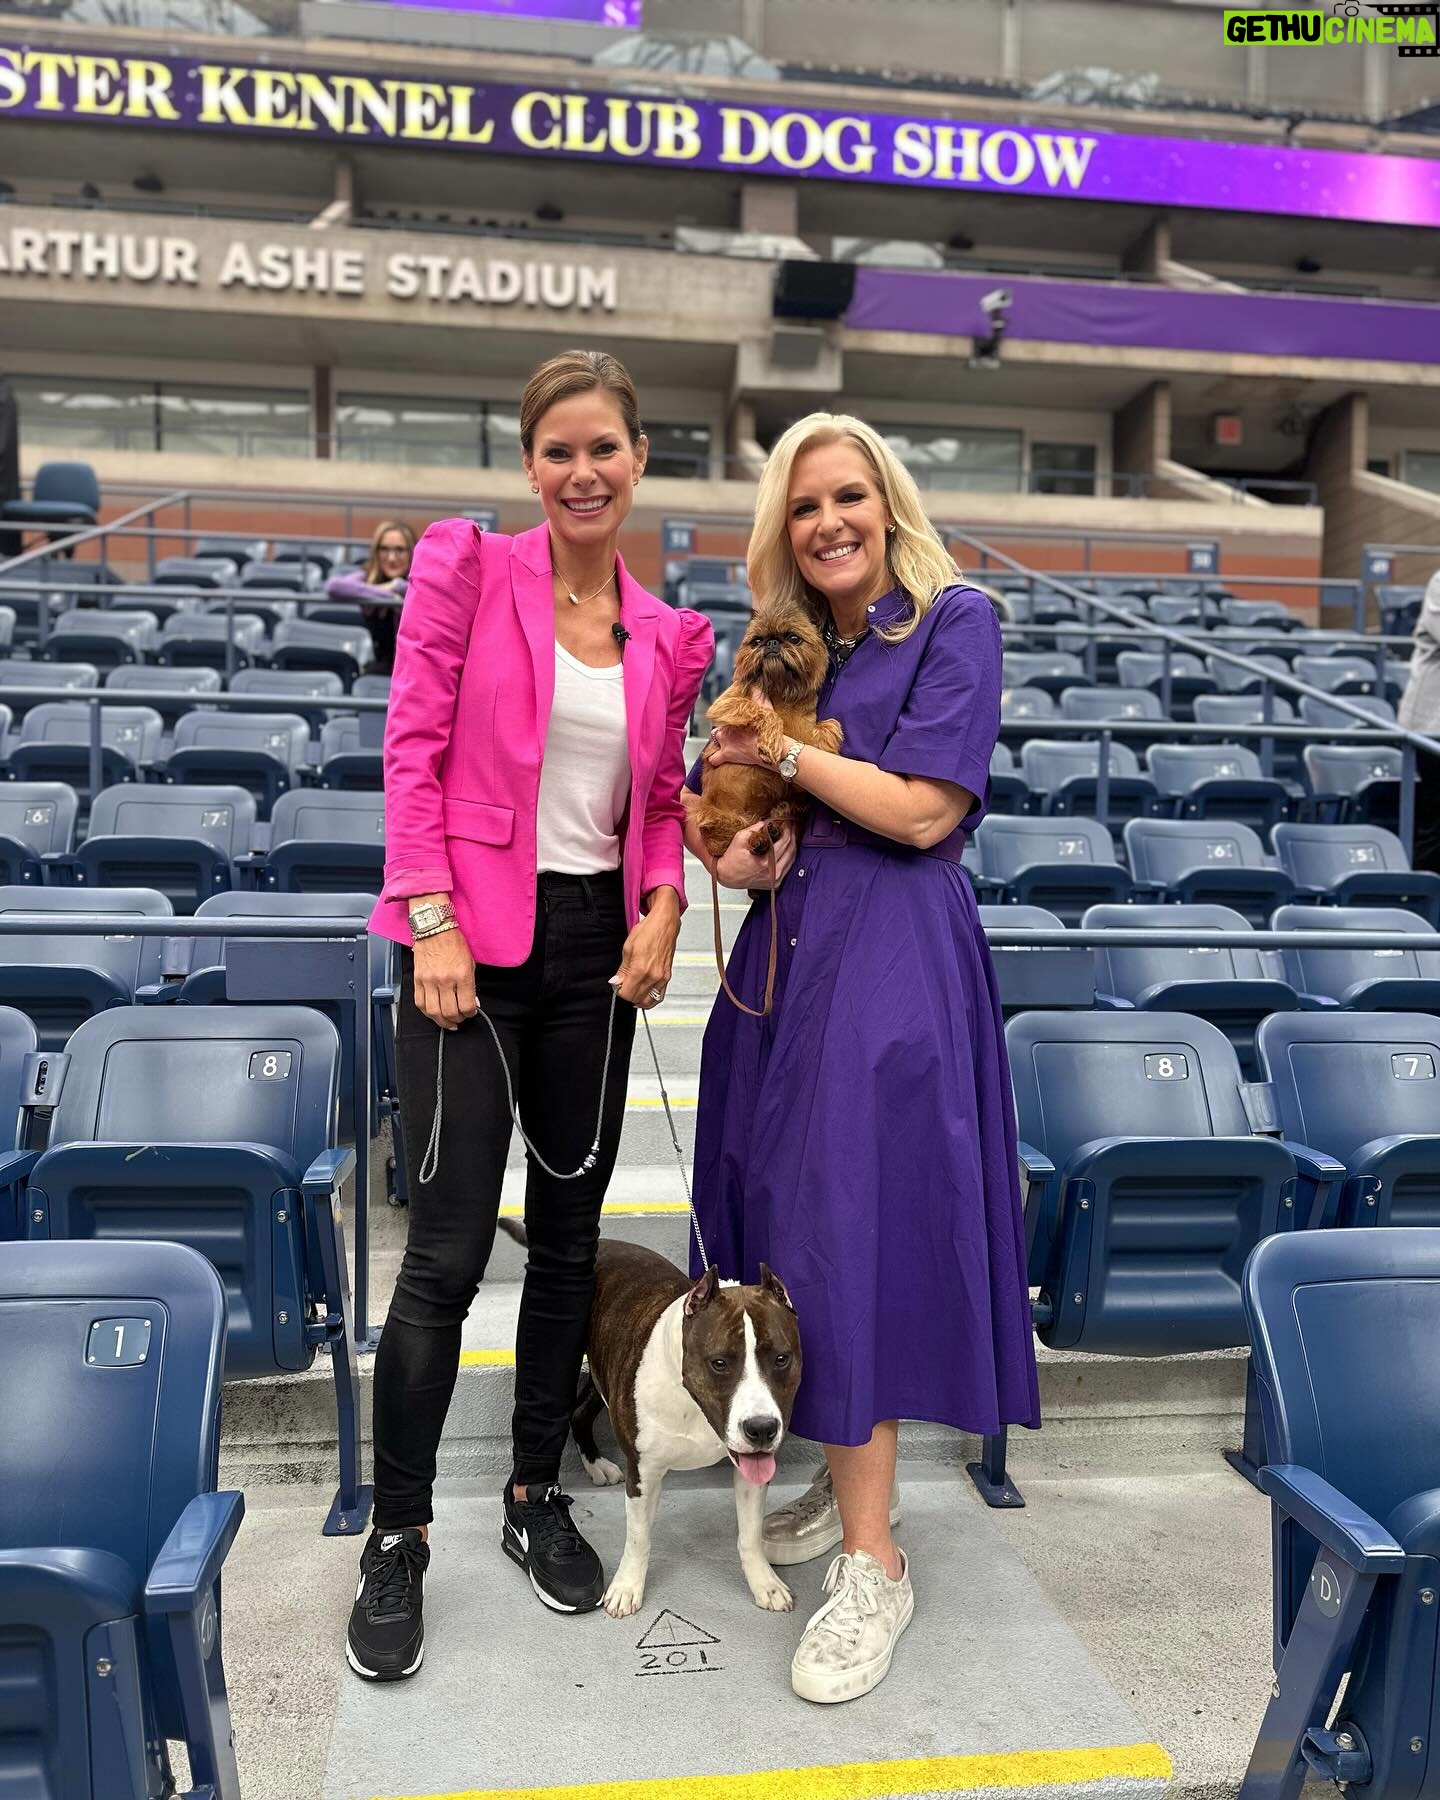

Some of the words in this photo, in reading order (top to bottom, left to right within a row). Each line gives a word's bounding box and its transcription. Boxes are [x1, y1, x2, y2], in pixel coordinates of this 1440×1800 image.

[197, 64, 496, 145] KENNEL
[511, 91, 702, 160] CLUB
[718, 106, 877, 174] DOG
[892, 121, 1099, 190] SHOW
[0, 227, 198, 281] RTHUR
[220, 241, 364, 294] ASHE
[387, 253, 618, 308] STADIUM
[32, 809, 43, 823] 6
[210, 812, 220, 826] 7
[1064, 841, 1076, 855] 7
[263, 1055, 277, 1077] 8
[1158, 1057, 1174, 1078] 8
[1404, 1057, 1418, 1077] 7
[114, 1325, 125, 1358] 1
[1320, 1575, 1331, 1601] D
[640, 1650, 708, 1670] 201
